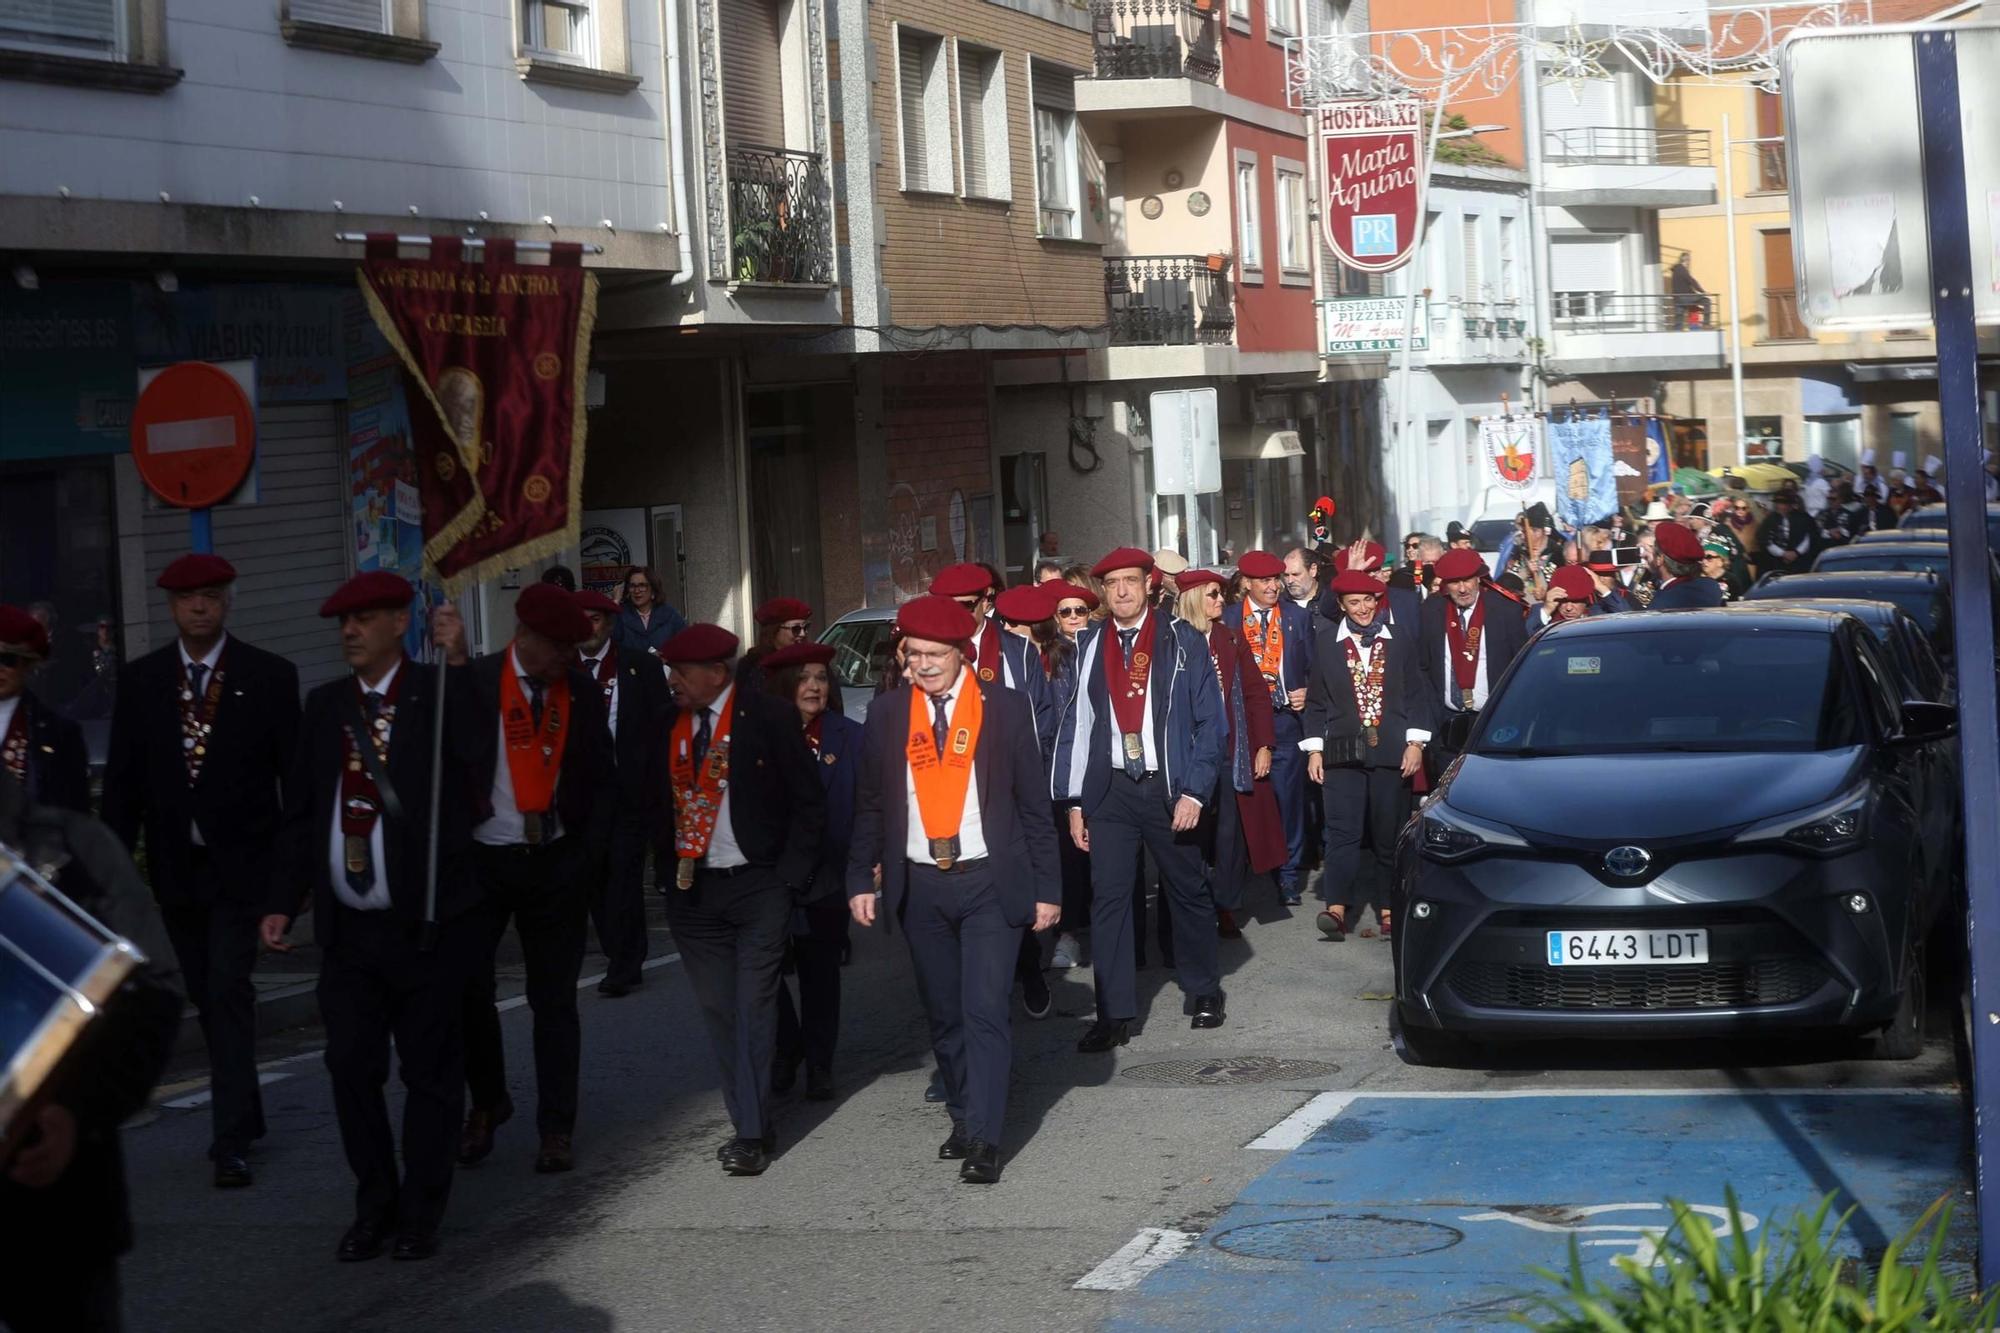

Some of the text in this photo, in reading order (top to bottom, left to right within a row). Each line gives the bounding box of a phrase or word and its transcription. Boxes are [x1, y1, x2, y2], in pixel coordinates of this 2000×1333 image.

[1358, 218, 1391, 244] PR
[1329, 299, 1422, 312] RESTAURANE
[1338, 310, 1404, 322] PIZZERI
[1331, 341, 1358, 351] CASA
[1361, 341, 1375, 350] DE
[1378, 340, 1391, 349] LA
[1553, 933, 1700, 960] E 6443 LDT
